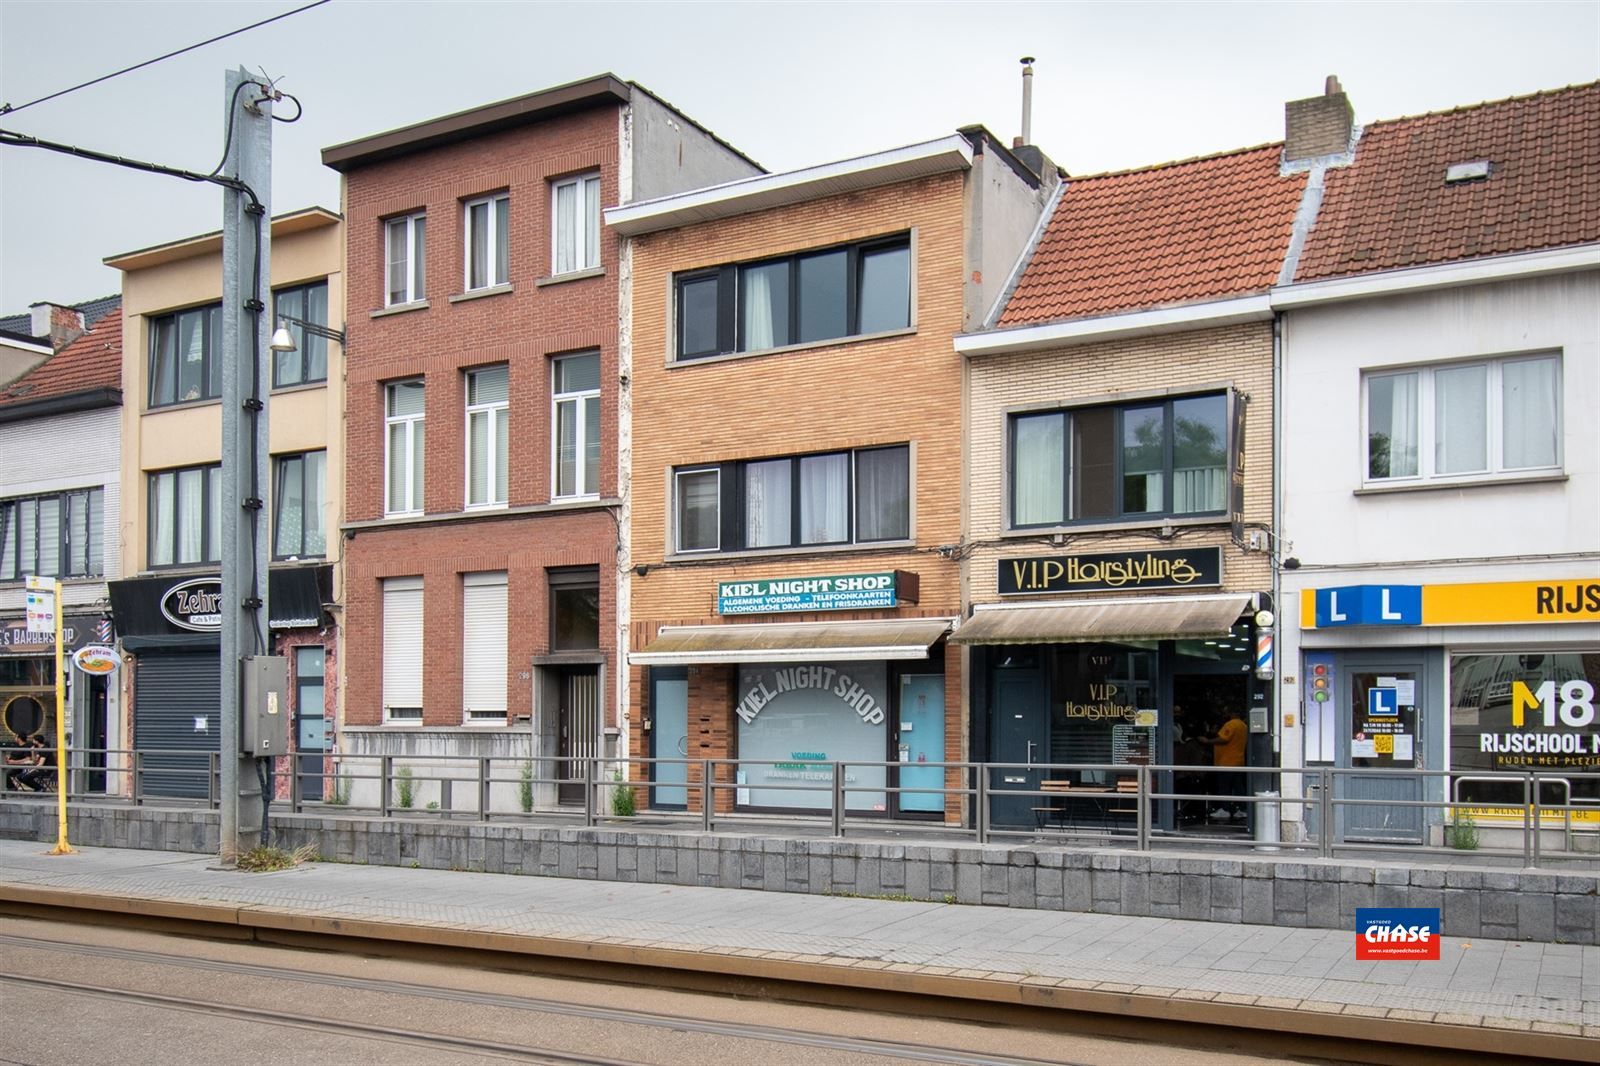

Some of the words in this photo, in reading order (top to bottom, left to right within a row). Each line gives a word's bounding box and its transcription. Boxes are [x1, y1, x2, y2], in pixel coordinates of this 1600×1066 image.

[1013, 560, 1064, 590] V.I.P
[1067, 553, 1203, 586] Hairstyling
[721, 584, 767, 597] KIEL
[769, 579, 832, 595] NIGHT
[835, 576, 891, 591] SHOP
[723, 597, 763, 606] ALGEMENE
[765, 595, 800, 604] VOEDING
[812, 592, 891, 602] TELEFOONKAARTEN
[723, 604, 780, 613] ALCOHOLISCHE
[782, 602, 820, 610] DRANKEN
[835, 599, 891, 608] FRISDRANKEN
[1331, 591, 1346, 621] L
[1382, 589, 1401, 619] L
[1537, 584, 1600, 614] RIJS
[0, 629, 10, 645] 'S
[13, 628, 74, 644] BARBERSOP
[735, 682, 778, 724] KIEL
[775, 666, 837, 693] NIGHT
[834, 675, 884, 725] SHOP
[1376, 692, 1390, 712] L
[1066, 701, 1138, 721] Hairstyling
[1480, 733, 1587, 754] RIJSCHOOL
[1540, 757, 1558, 765] MET
